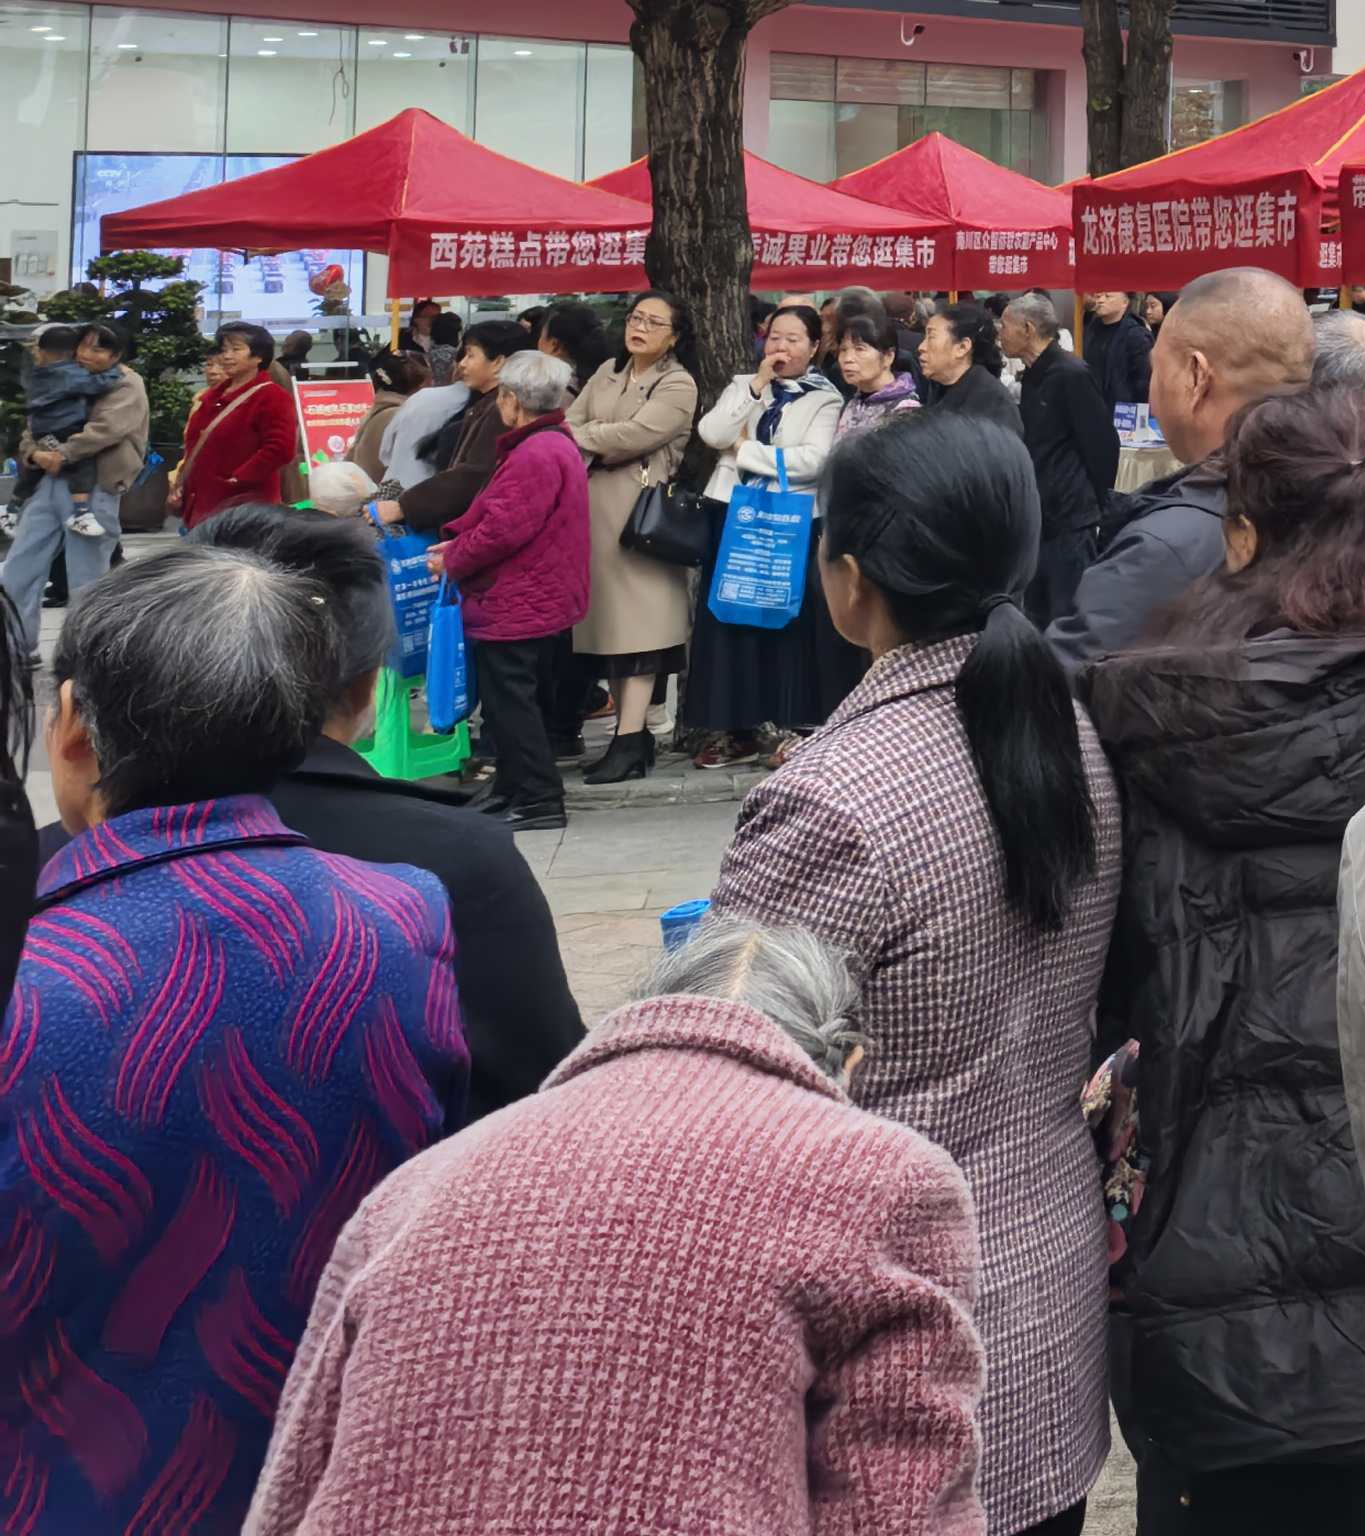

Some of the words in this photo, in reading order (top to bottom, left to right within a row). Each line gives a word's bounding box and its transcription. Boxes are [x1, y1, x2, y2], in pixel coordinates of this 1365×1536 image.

[1080, 189, 1298, 257] 龙济康复医院带您逛集市
